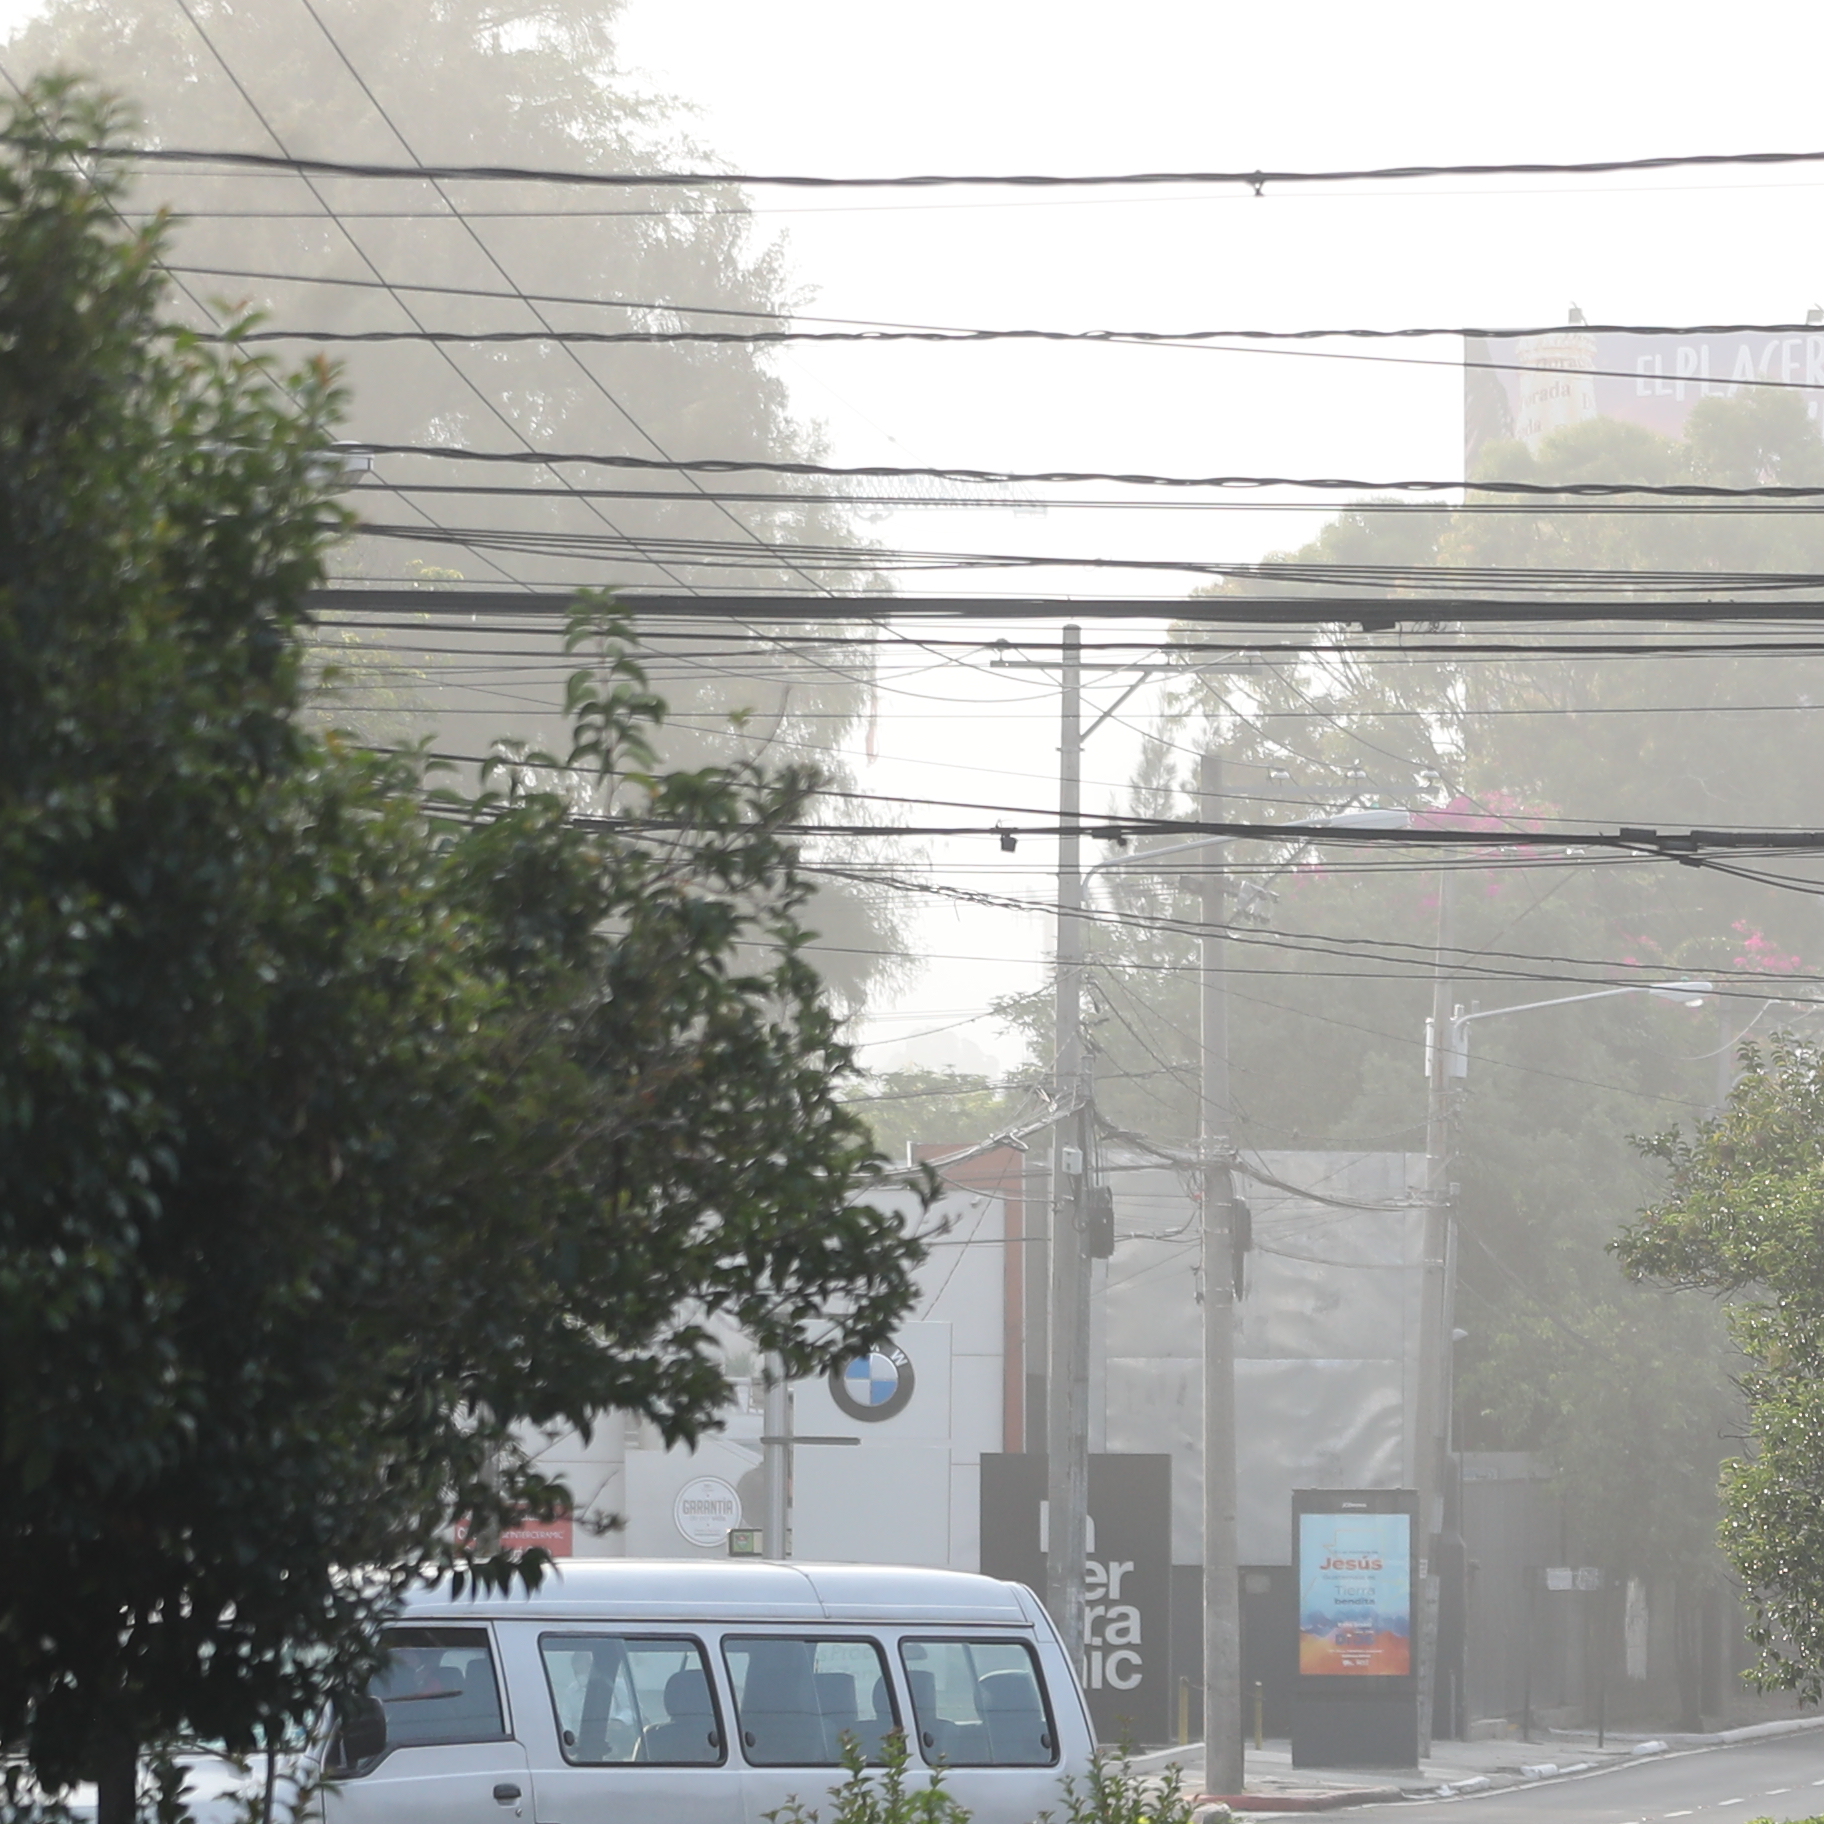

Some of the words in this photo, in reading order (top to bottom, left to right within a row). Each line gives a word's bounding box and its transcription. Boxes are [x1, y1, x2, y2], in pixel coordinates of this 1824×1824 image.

[1636, 355, 1673, 397] EL
[1085, 1559, 1135, 1600] er
[1319, 1555, 1384, 1571] Jesús
[1334, 1585, 1376, 1596] Tierra
[1085, 1604, 1142, 1646] ra
